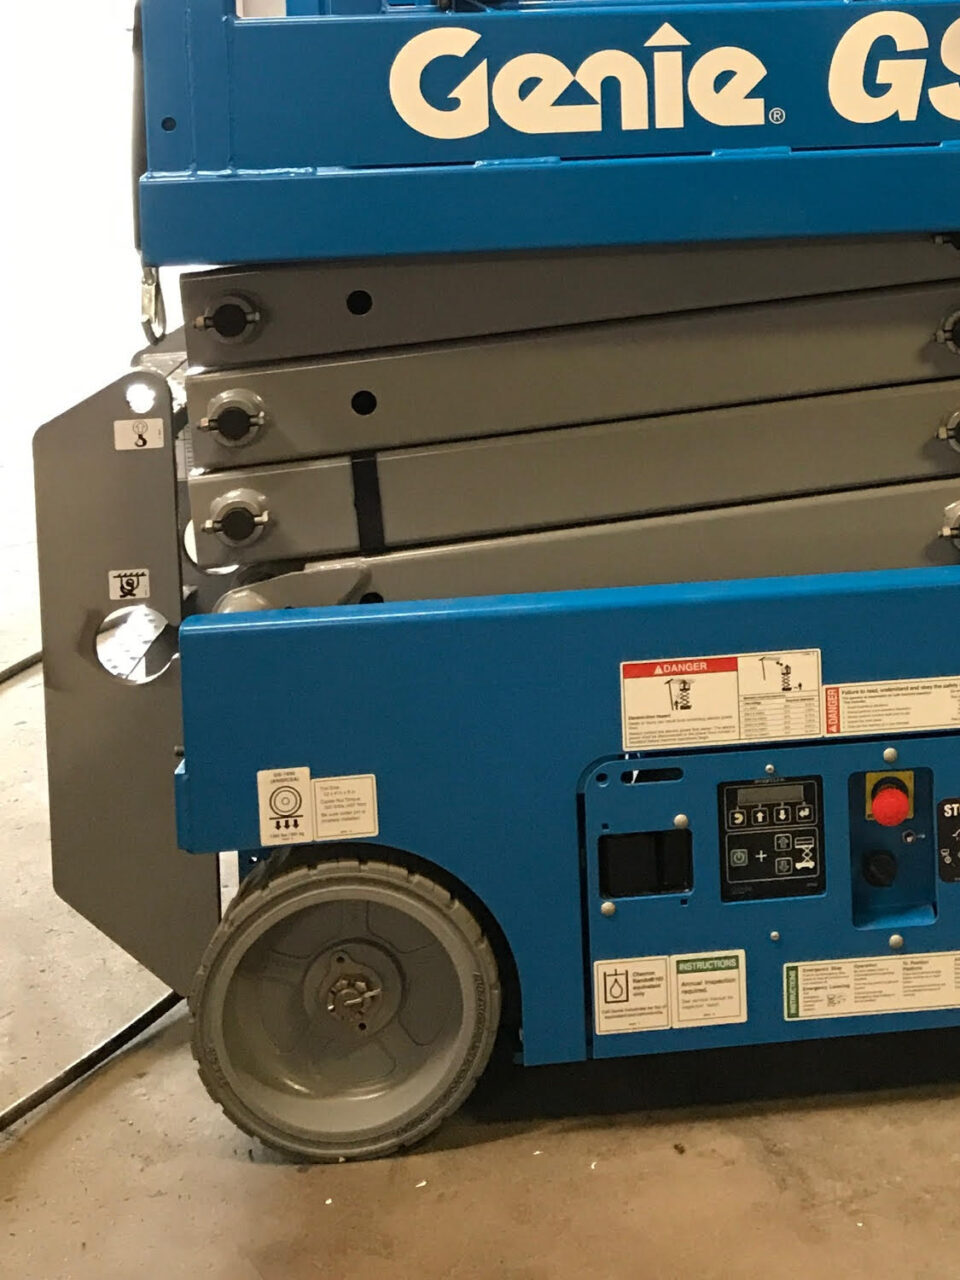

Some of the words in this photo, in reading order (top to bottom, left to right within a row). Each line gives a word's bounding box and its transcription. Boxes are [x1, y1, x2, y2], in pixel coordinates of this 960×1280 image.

[389, 22, 769, 139] Genie
[664, 662, 707, 673] DANGER
[827, 689, 839, 724] DANGER
[678, 958, 737, 971] INSTRUCTIONS
